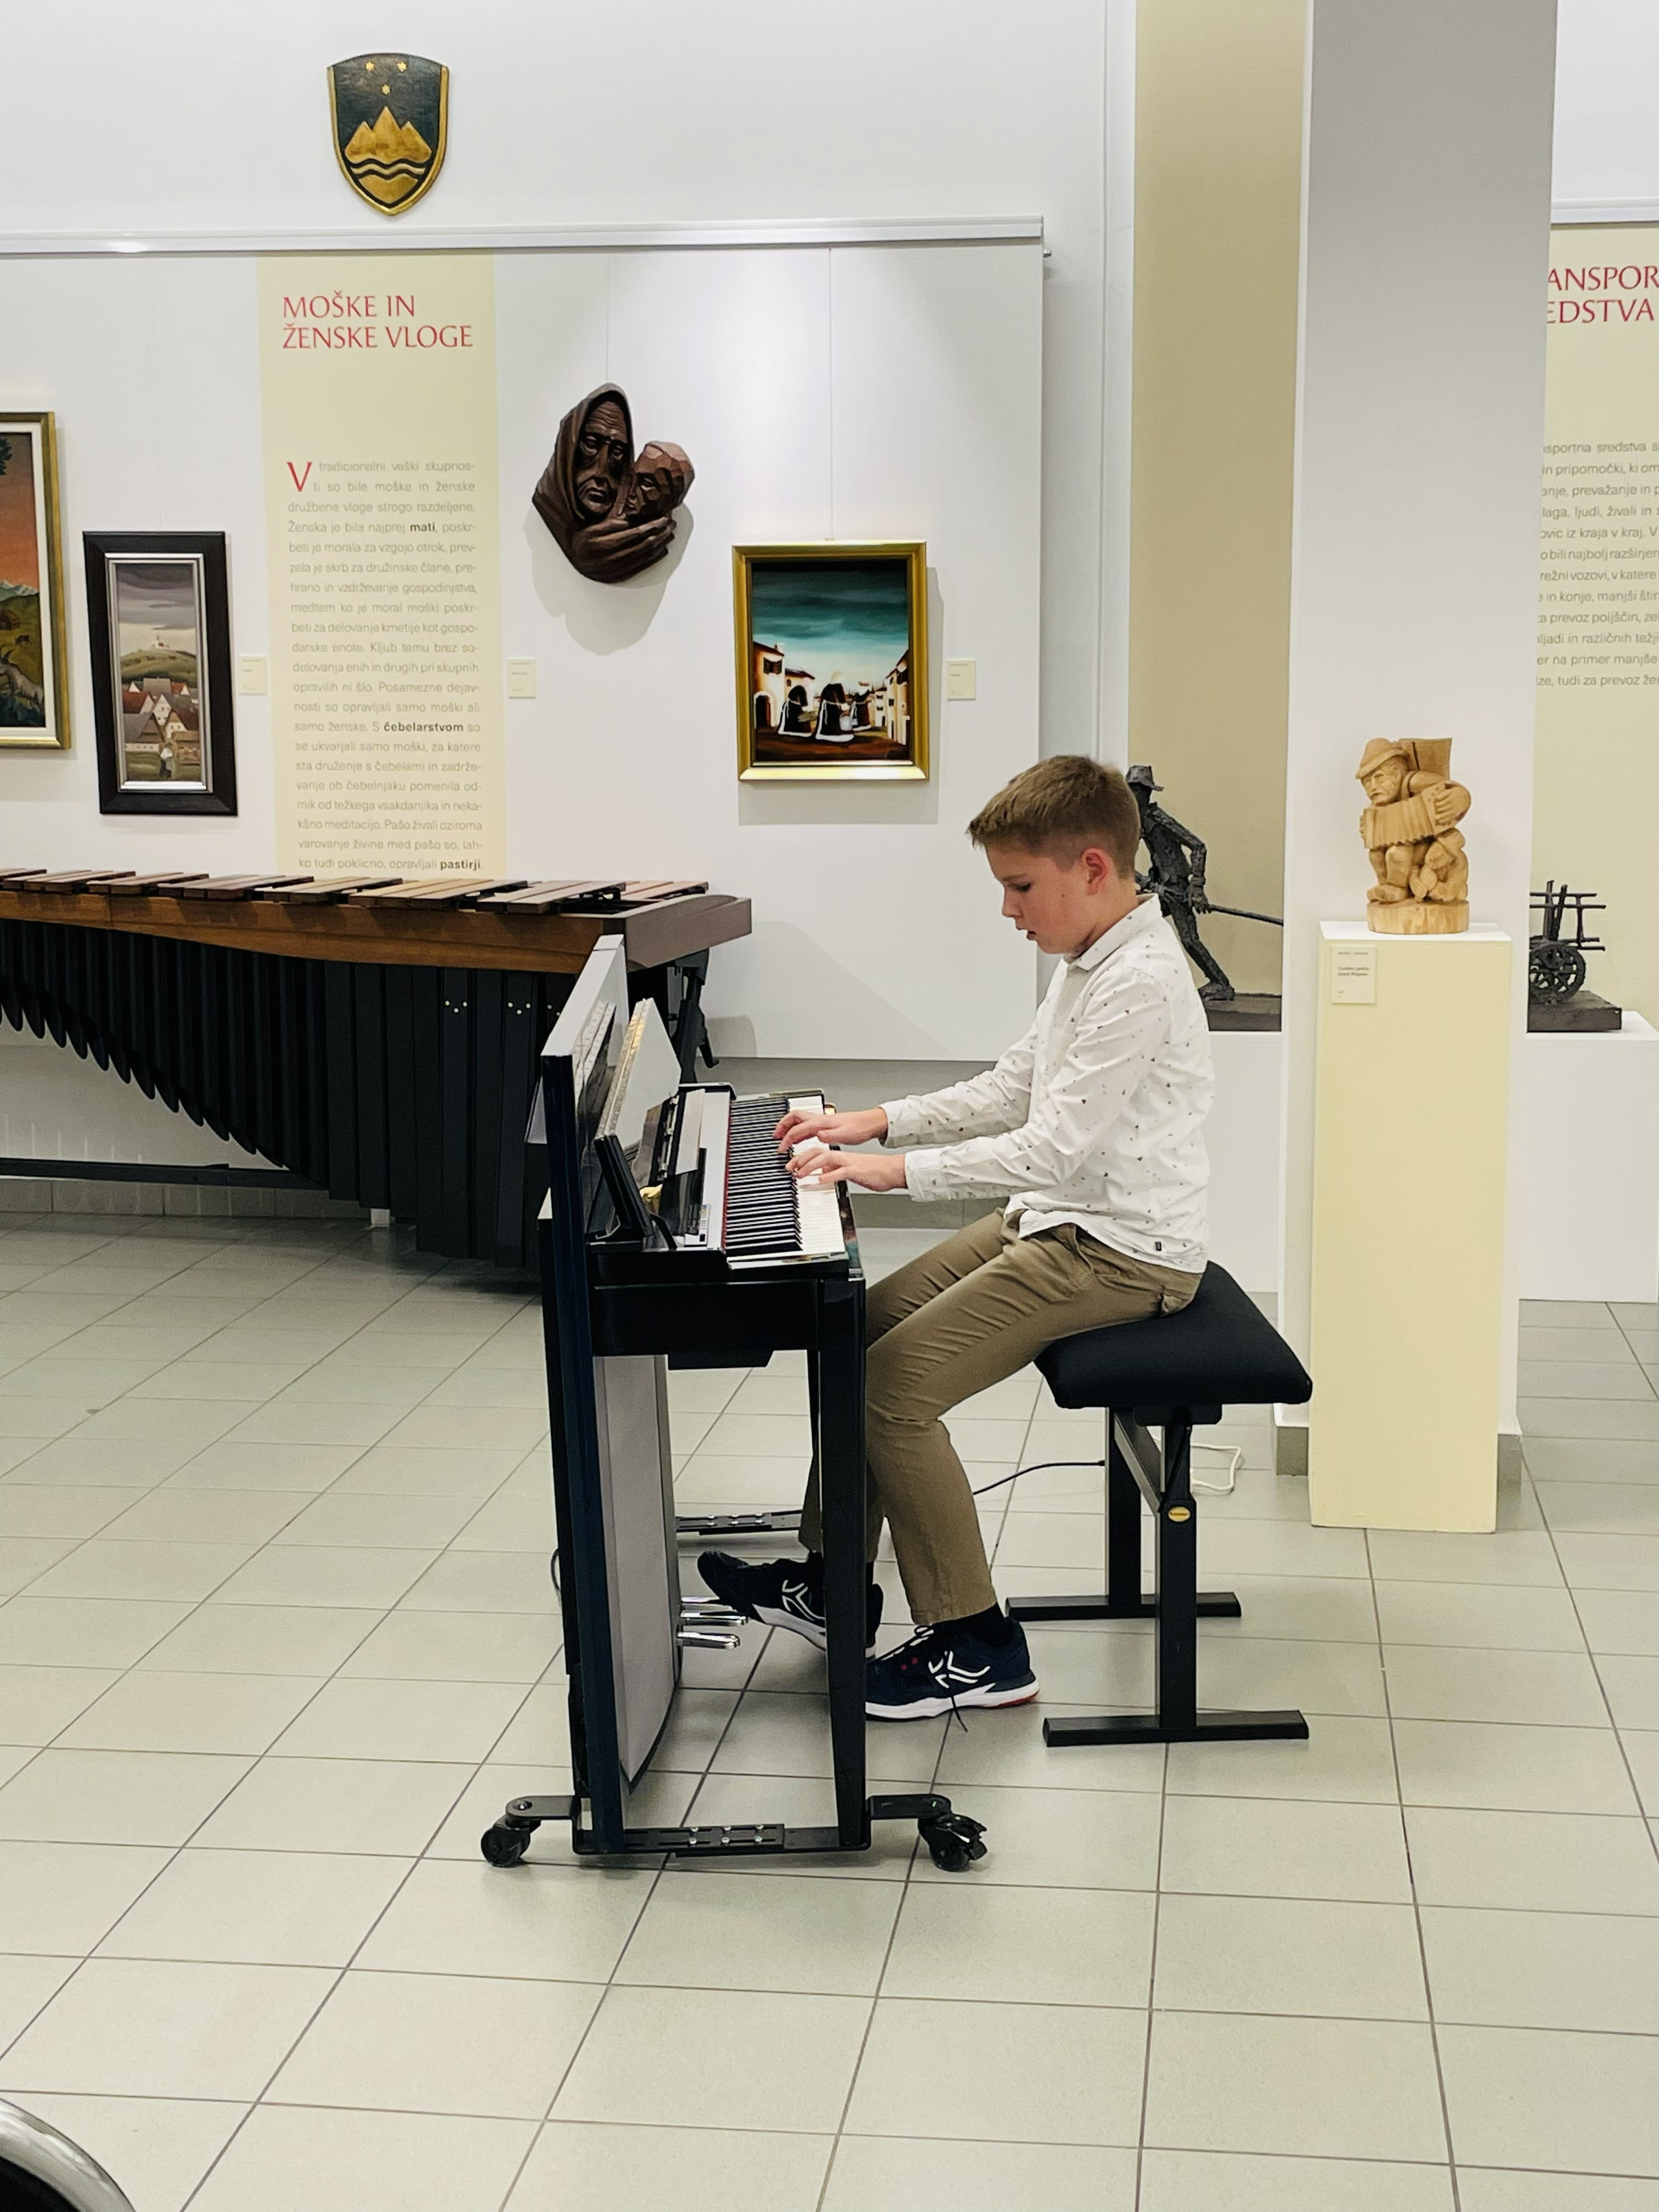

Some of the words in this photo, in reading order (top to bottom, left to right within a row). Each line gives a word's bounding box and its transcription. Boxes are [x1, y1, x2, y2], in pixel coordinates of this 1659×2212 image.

[282, 290, 377, 318] MOŠKE
[387, 295, 416, 318] IN
[282, 322, 378, 349] ŽENSKE
[385, 324, 473, 348] VLOGE
[1596, 441, 1647, 453] sredstva
[319, 461, 386, 472] tradicionalni
[391, 460, 419, 472] vaški
[425, 460, 475, 473] skupnos-
[1555, 463, 1627, 477] pripomočki,
[286, 460, 314, 492] V
[326, 483, 341, 492] so
[347, 481, 368, 492] bile
[375, 481, 412, 492] moške
[419, 481, 430, 492] in
[436, 481, 476, 492] ženske
[1571, 484, 1638, 499] prevažanje
[1640, 484, 1652, 495] in
[287, 501, 340, 512] družbene
[342, 501, 374, 515] vloge
[377, 502, 413, 515] strogo
[1606, 505, 1637, 517] živali
[1641, 505, 1652, 516] in
[287, 520, 327, 533] Ženska
[345, 522, 364, 533] bila
[368, 522, 405, 534] najprej
[442, 522, 476, 534] poskr-
[1579, 527, 1609, 541] kraja
[1621, 526, 1646, 540] kraj.
[1649, 526, 1658, 537] V
[289, 542, 309, 553] beti
[324, 542, 362, 552] morala
[363, 544, 376, 553] za
[378, 543, 414, 555] vzgojo
[449, 544, 477, 555] prev-
[1567, 548, 1609, 562] najbolj
[289, 562, 311, 573] zela
[325, 562, 349, 573] skrb
[351, 564, 364, 573] za
[365, 562, 419, 573] družinske
[420, 562, 454, 573] člane,
[455, 564, 477, 575] pre-
[1539, 569, 1569, 582] režni
[1620, 568, 1657, 580] katere
[290, 582, 321, 593] hrano
[324, 583, 334, 592] in
[337, 582, 399, 595] vzdrževanje
[402, 582, 478, 595] gospodinjstva,
[1546, 593, 1557, 602] in
[1559, 590, 1595, 605] konje,
[1597, 591, 1637, 604] manjši
[290, 602, 336, 613] medtem
[340, 602, 353, 613] ko
[371, 602, 403, 613] moral
[407, 602, 439, 613] moški
[444, 602, 478, 615] poskr-
[1549, 613, 1590, 624] prevoz
[1591, 611, 1641, 625] poljščin,
[291, 623, 312, 633] beti
[313, 624, 326, 633] za
[328, 623, 380, 635] delovanje
[381, 623, 421, 635] kmetije
[422, 623, 439, 633] kot
[440, 624, 479, 636] gospo-
[1567, 634, 1579, 644] in
[1582, 633, 1632, 645] različnih
[291, 642, 328, 653] darske
[370, 642, 398, 655] Kljub
[401, 643, 430, 653] temu
[433, 642, 458, 653] brez
[1552, 656, 1567, 665] na
[1570, 653, 1611, 667] primer
[1613, 653, 1658, 667] manjše
[292, 662, 344, 675] delovanja
[346, 662, 370, 673] enih
[371, 663, 382, 672] in
[383, 662, 419, 675] drugih
[420, 663, 435, 675] pri
[436, 662, 479, 675] skupnih
[292, 682, 338, 694] opravilih
[379, 681, 443, 693] Posamezne
[447, 682, 480, 695] dejav-
[1557, 676, 1581, 687] tudi
[1583, 676, 1597, 686] za
[1600, 676, 1640, 687] prevoz
[294, 702, 321, 712] nosti
[325, 703, 338, 712] so
[342, 702, 392, 714] opravljali
[396, 704, 427, 713] samo
[430, 702, 464, 713] moški
[467, 702, 481, 713] ali
[294, 723, 325, 732] samo
[372, 721, 380, 732] S
[383, 721, 464, 732] čebelarstvom
[467, 724, 481, 732] so
[295, 742, 308, 751] se
[311, 741, 356, 753] ukvarjali
[359, 743, 390, 752] samo
[431, 743, 444, 752] za
[447, 741, 481, 753] katere
[296, 761, 313, 771] sta
[315, 760, 363, 773] druženje
[374, 760, 425, 771] čebelami
[428, 761, 438, 771] in
[441, 761, 482, 772] zadrže-
[296, 781, 325, 792] vanje
[329, 781, 343, 791] ob
[409, 781, 460, 793] pomenila
[464, 781, 482, 792] od-
[297, 799, 316, 809] mik
[318, 799, 332, 810] od
[334, 799, 375, 812] težkega
[376, 800, 439, 812] vsakdanjika
[441, 800, 451, 810] in
[453, 800, 482, 811] neka-
[297, 819, 323, 830] kšno
[384, 819, 411, 830] Pašo
[412, 820, 439, 830] živali
[439, 820, 483, 831] oziroma
[298, 840, 350, 851] varovanje
[352, 838, 384, 849] živine
[387, 839, 411, 850] med
[414, 839, 441, 851] pašo
[444, 842, 460, 851] so,
[298, 858, 312, 868] ko
[314, 858, 335, 868] tudi
[388, 859, 437, 871] opravljali
